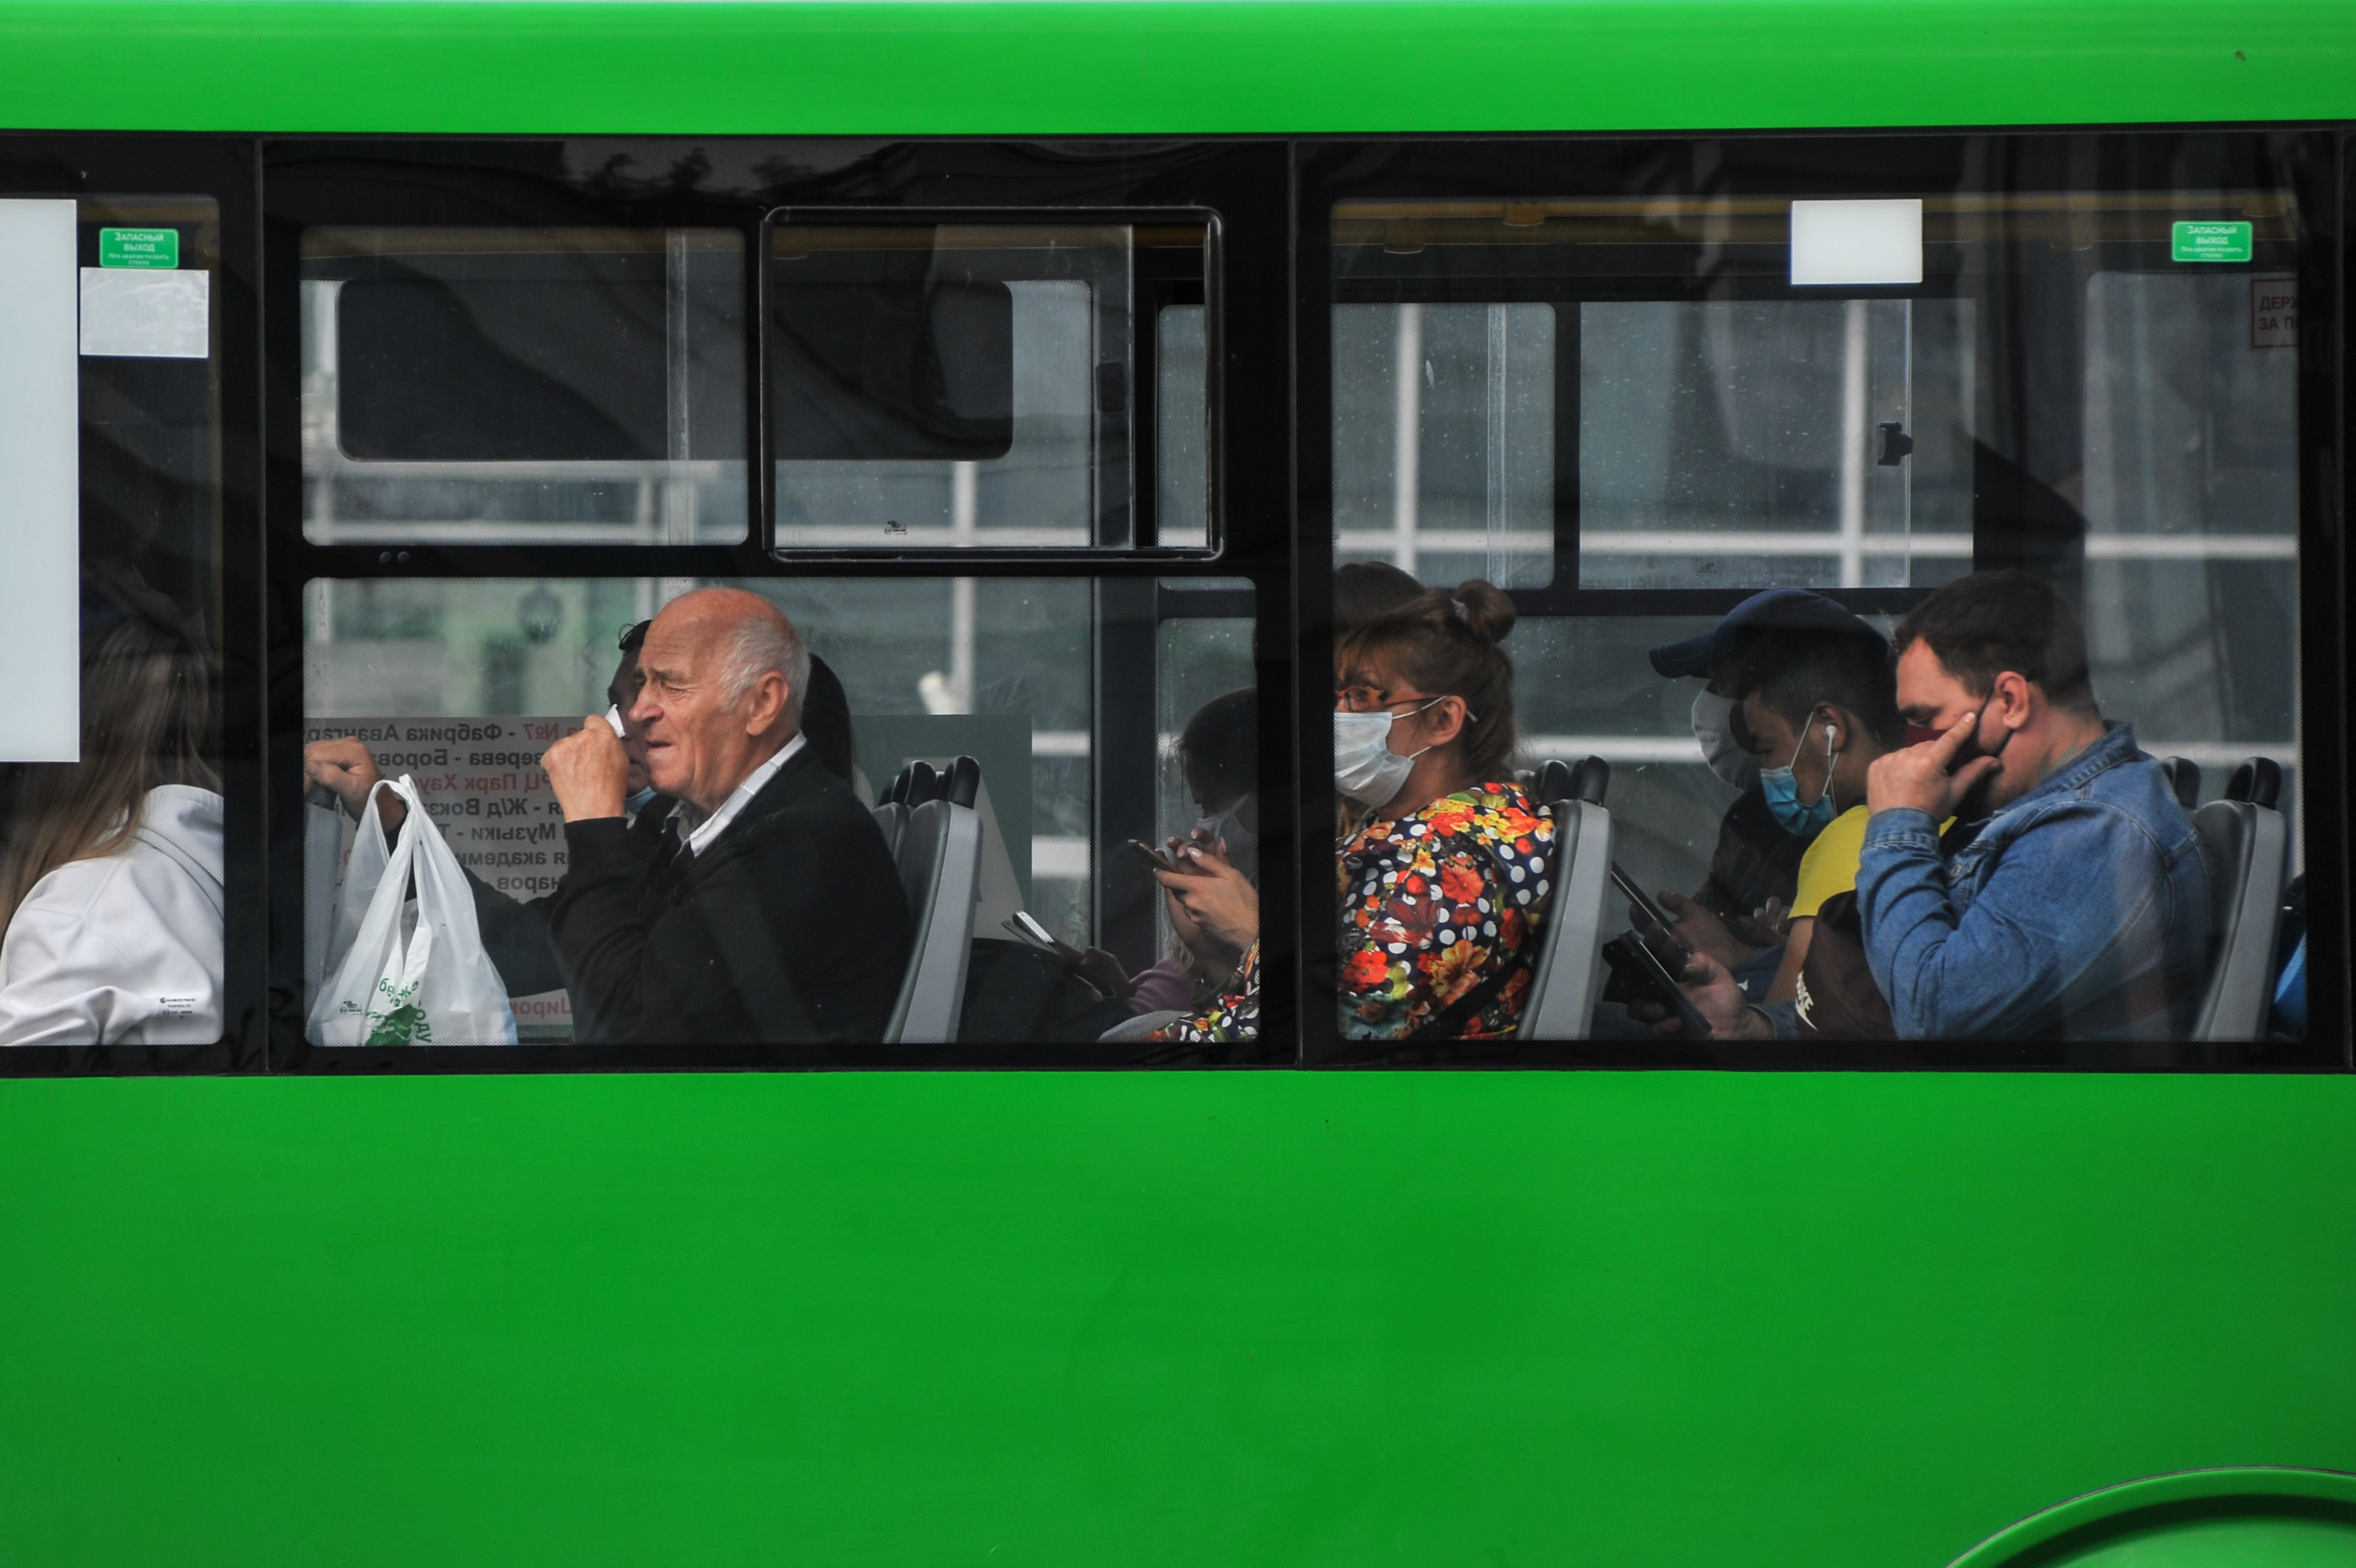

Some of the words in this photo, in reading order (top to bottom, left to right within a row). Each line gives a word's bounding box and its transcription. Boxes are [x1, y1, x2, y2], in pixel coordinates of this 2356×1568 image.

[114, 232, 164, 242] ЗАПАСНЫЙ
[123, 243, 156, 253] ВЫХОД
[2258, 317, 2279, 330] ЗА
[2284, 316, 2298, 329] П
